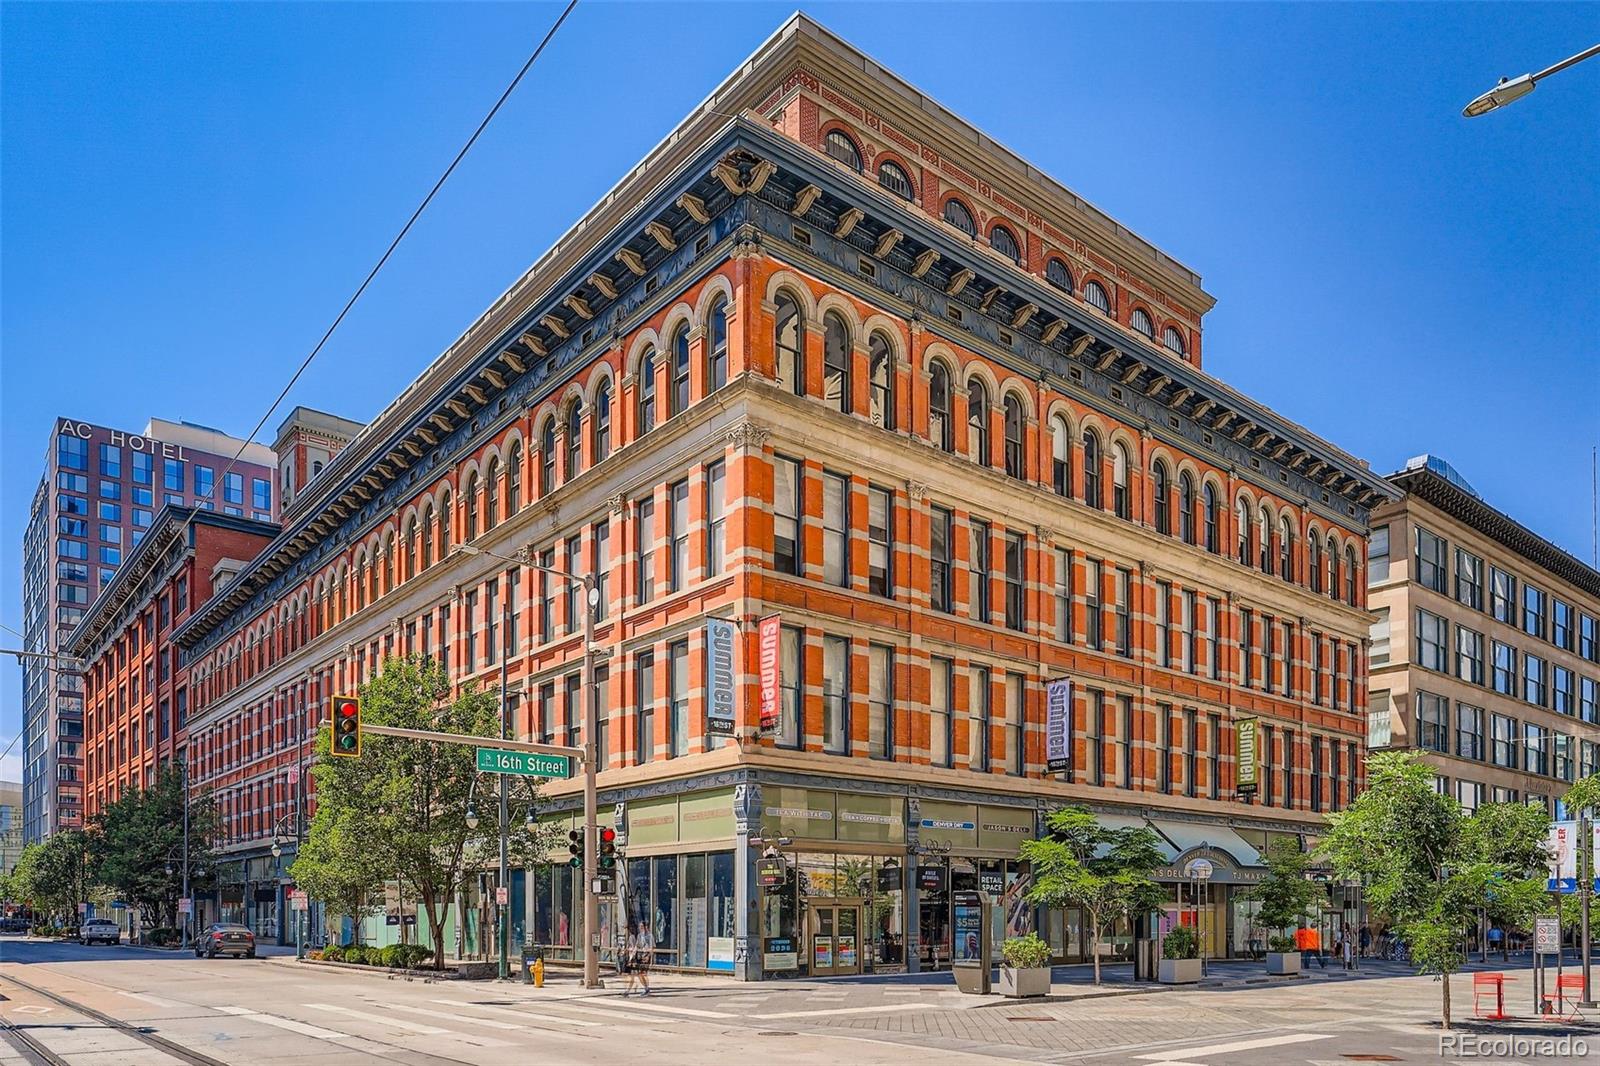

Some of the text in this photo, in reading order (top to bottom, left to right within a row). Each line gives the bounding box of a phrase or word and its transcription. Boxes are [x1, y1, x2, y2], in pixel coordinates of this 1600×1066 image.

[60, 420, 190, 462] AC HOTEL
[496, 754, 564, 774] 16th Street
[933, 820, 952, 828] DENVER
[981, 876, 1003, 884] RETAIL
[981, 884, 1003, 892] SPACE
